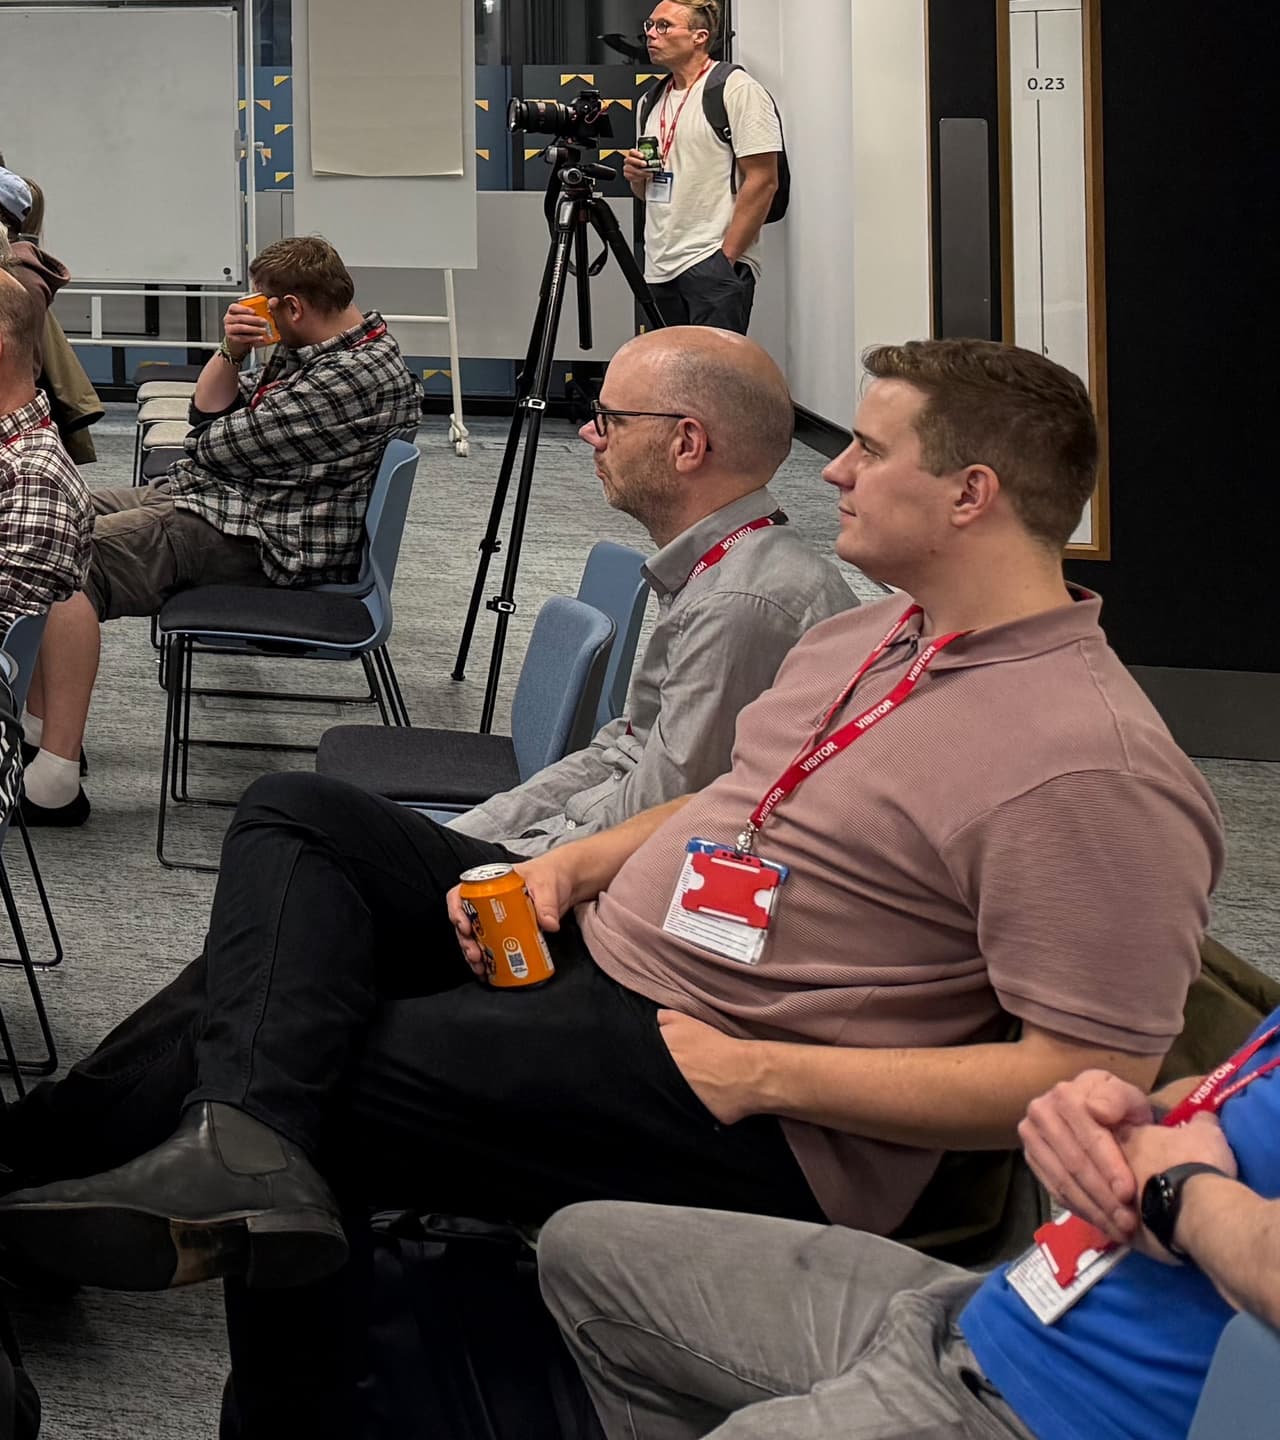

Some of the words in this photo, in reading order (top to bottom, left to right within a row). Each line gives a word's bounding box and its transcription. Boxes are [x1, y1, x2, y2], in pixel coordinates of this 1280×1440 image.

[1027, 77, 1065, 90] 0.23
[720, 525, 754, 551] VISITOR
[855, 699, 894, 730] VISITOR
[800, 741, 838, 772] VISITOR
[758, 787, 785, 823] VISITOR
[1189, 1063, 1236, 1105] VISITOR
